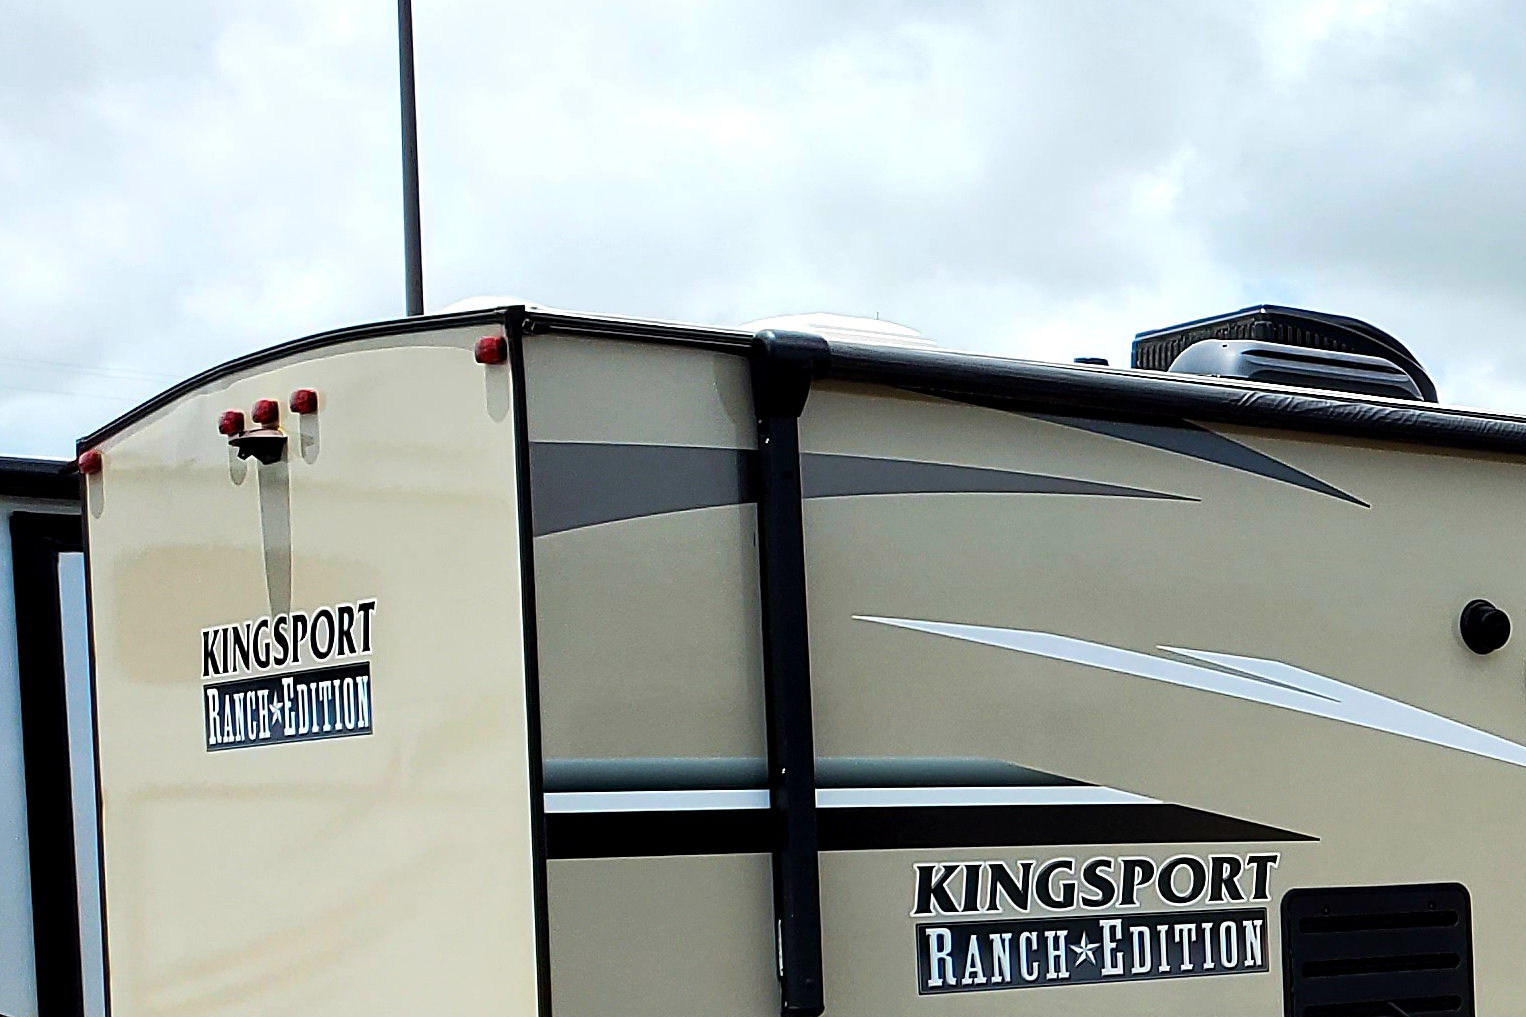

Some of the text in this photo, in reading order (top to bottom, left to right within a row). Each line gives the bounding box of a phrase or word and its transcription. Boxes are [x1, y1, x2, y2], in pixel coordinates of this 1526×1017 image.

[202, 600, 376, 678] KINGSPORT
[207, 675, 369, 745] RANCH EDITION
[913, 854, 1279, 915] KINGSPORT
[926, 919, 1263, 988] RANCH EDITION
